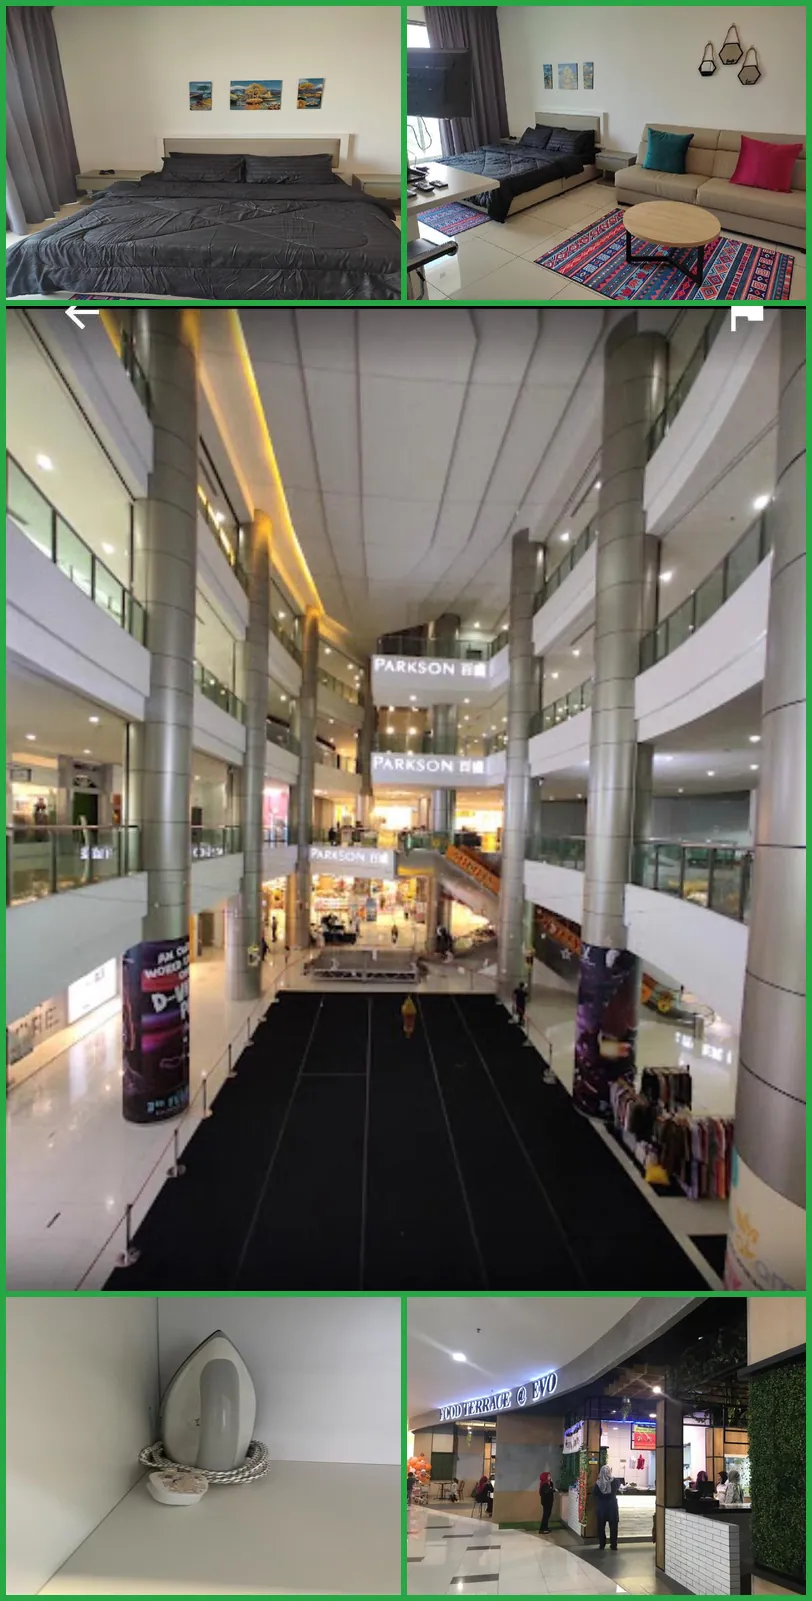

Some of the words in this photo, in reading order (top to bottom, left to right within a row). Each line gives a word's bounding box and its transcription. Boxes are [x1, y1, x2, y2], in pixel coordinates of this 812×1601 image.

[374, 658, 455, 675] PARKSON
[373, 756, 453, 773] PARKSON
[311, 847, 366, 862] PARKSON
[464, 1390, 512, 1417] TERRACE
[516, 1385, 527, 1407] @
[532, 1372, 558, 1402] EVO
